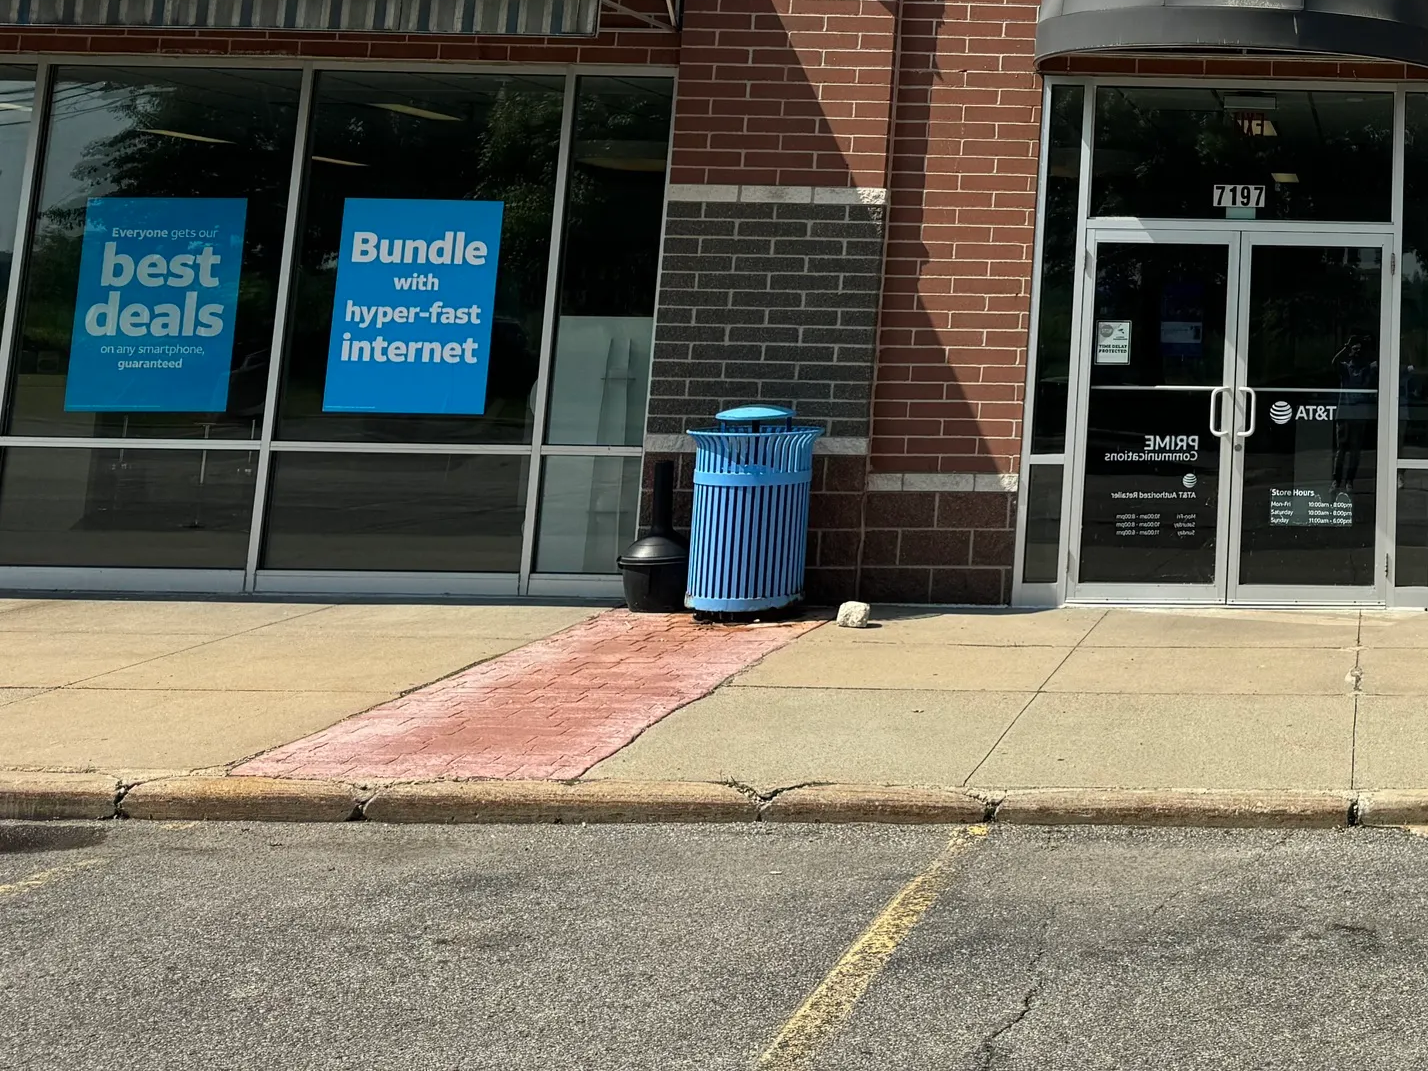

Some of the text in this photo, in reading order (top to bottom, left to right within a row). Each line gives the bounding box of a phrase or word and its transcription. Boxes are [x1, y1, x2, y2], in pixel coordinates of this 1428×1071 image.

[1215, 185, 1264, 207] 7197
[112, 227, 219, 240] Everyone gets our
[351, 231, 488, 266] Bundle
[100, 241, 221, 288] best
[393, 272, 439, 291] with
[84, 290, 225, 337] deals
[345, 299, 482, 329] hyper-fast
[100, 344, 205, 356] on any smartphone,
[340, 332, 479, 363] internet
[117, 358, 183, 370] guaranteed
[1295, 405, 1337, 420] AT&T
